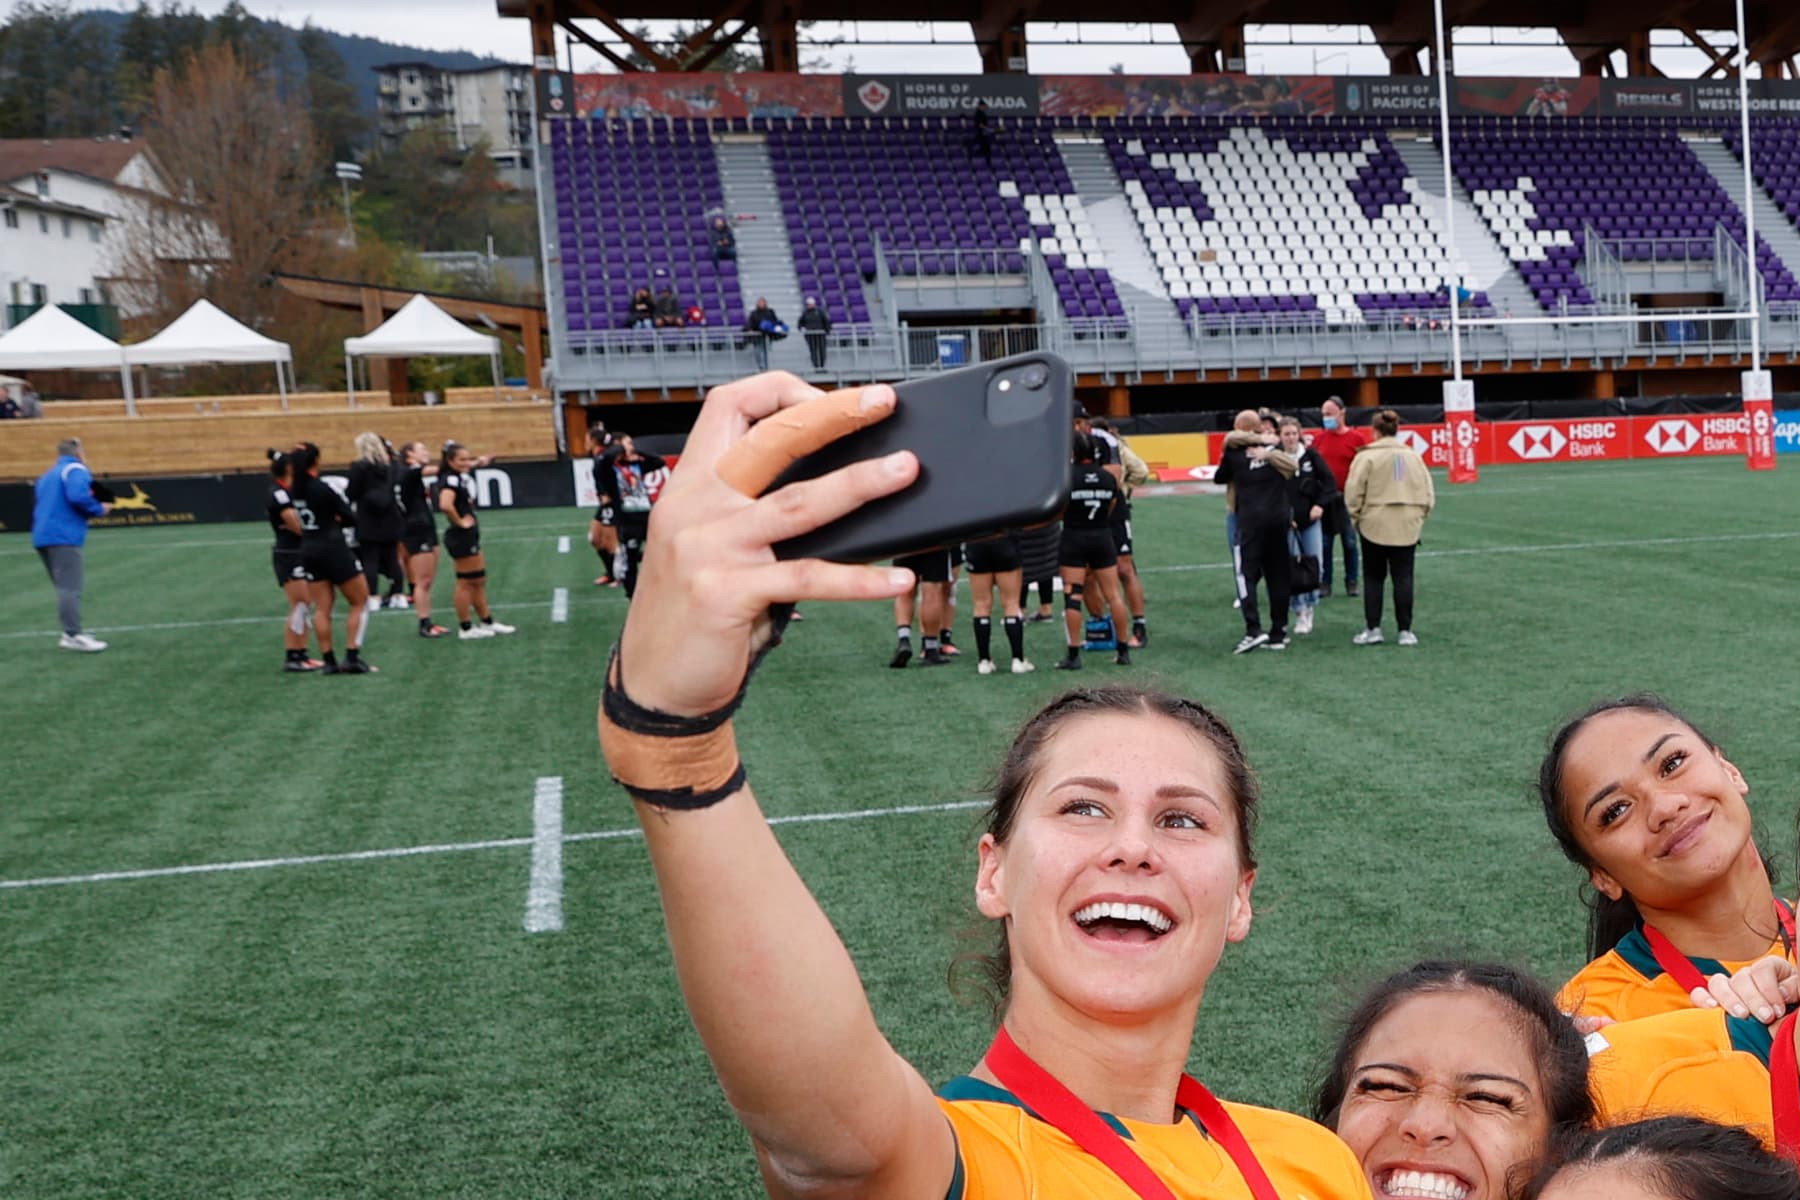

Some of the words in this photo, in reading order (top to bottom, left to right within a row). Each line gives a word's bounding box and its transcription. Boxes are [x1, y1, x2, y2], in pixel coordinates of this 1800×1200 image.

[904, 84, 946, 94] HOME
[951, 84, 969, 94] OF
[906, 96, 959, 110] RUGBY
[1697, 99, 1778, 111] WESTSORE
[1569, 422, 1617, 439] HSBC
[1570, 441, 1606, 458] Bank
[1703, 436, 1738, 453] Bank
[1083, 500, 1102, 520] 7
